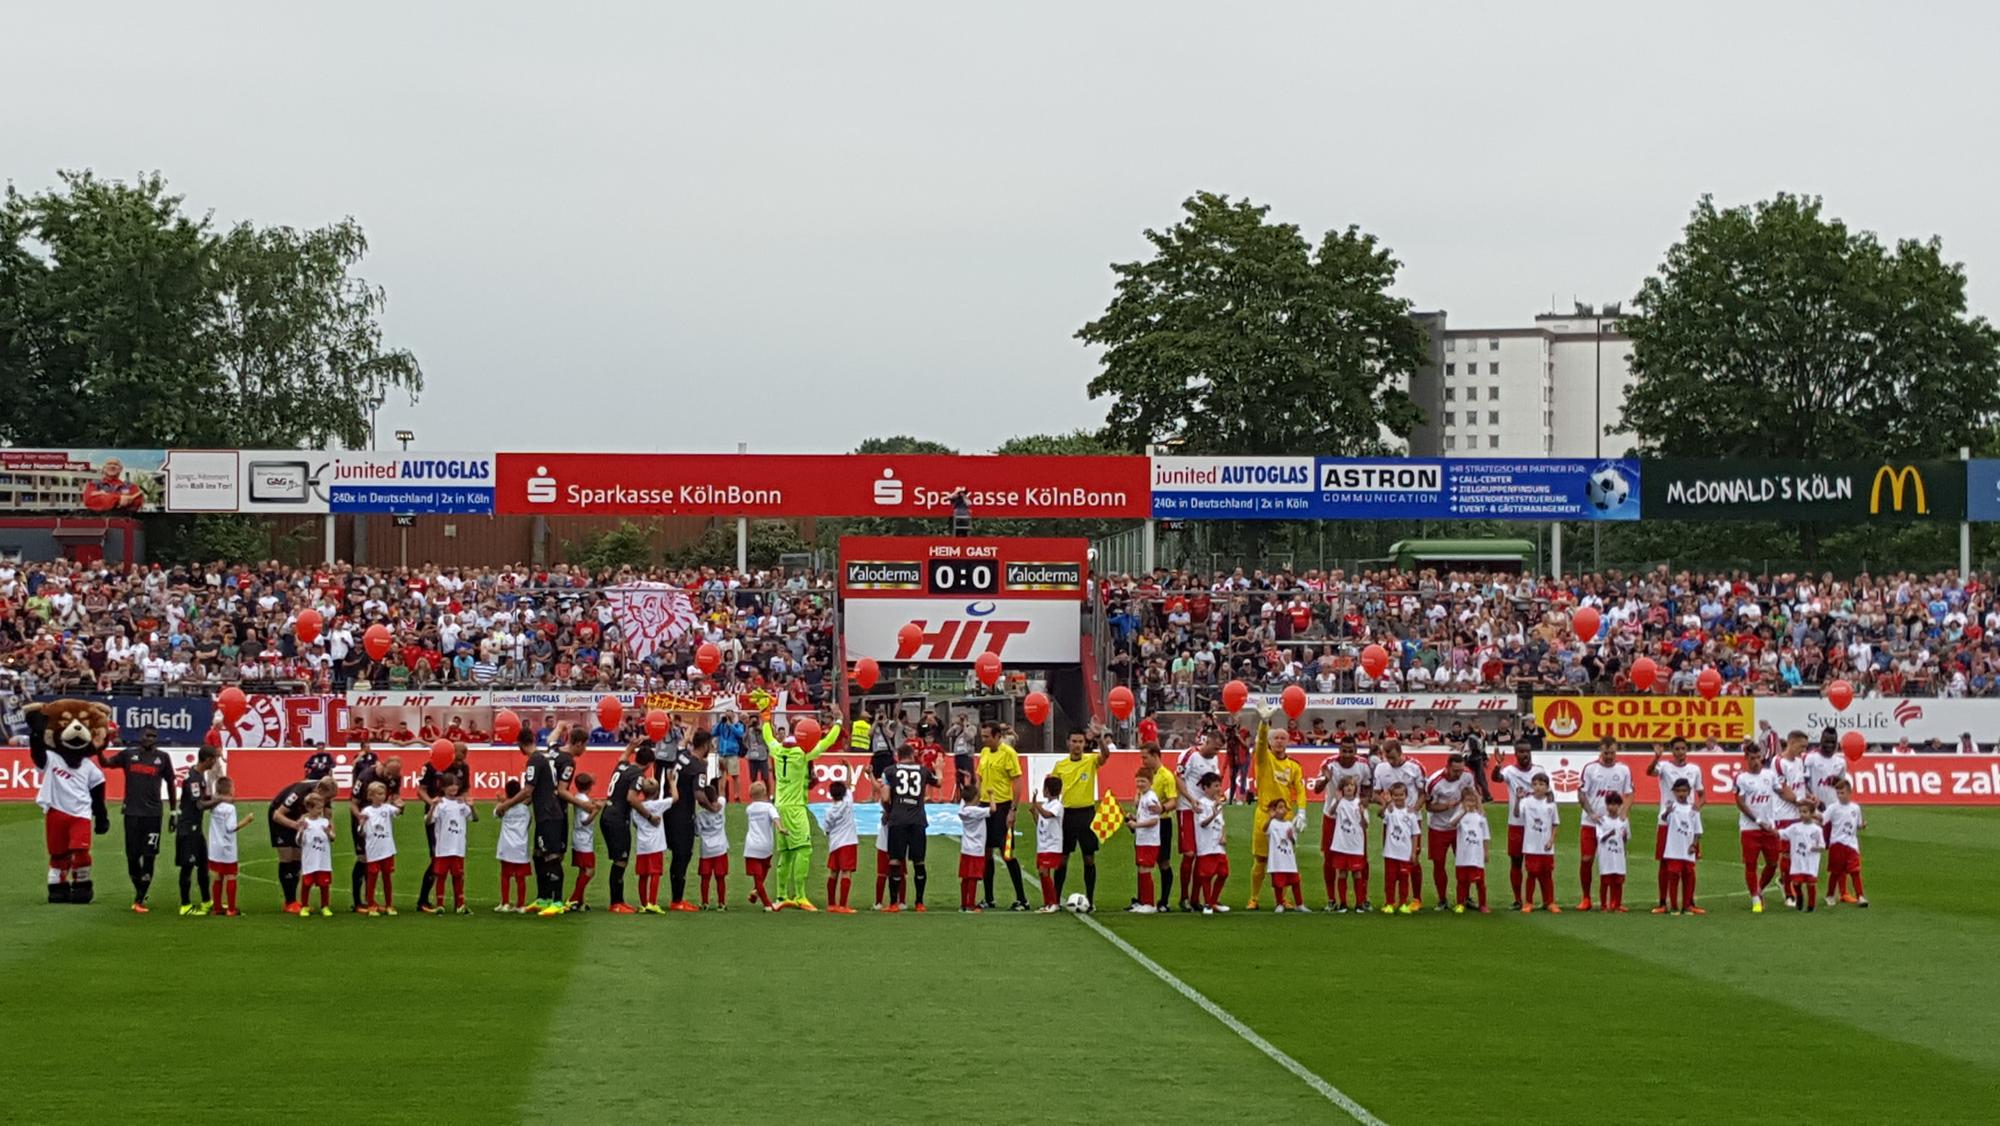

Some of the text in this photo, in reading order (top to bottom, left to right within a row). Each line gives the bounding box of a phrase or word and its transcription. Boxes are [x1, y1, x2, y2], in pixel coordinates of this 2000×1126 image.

[334, 459, 490, 480] junited AUTOGLAS
[1156, 464, 1308, 486] junited AUTOGLAS
[1464, 466, 1528, 474] STRATEGISCHER
[1324, 469, 1437, 488] ASTRON
[1797, 473, 1852, 501] KÖLN
[332, 492, 490, 504] 240x in Deutschland 2x in Köln
[567, 484, 782, 507] Sparkasse KölnBonn
[1025, 487, 1126, 507] KölnBonn
[1323, 493, 1438, 503] COMMUNICATION
[1458, 495, 1568, 503] AUSSENDIENSTSTEUERUNG
[1154, 498, 1308, 509] 240x in Deutschland 2x in Köln
[1498, 504, 1581, 512] GÄSTEMANAGEMENT
[397, 517, 412, 525] WC
[1170, 521, 1184, 529] WC
[929, 546, 998, 557] HEIM GAST
[849, 565, 920, 582] Kaloderma
[1008, 566, 1078, 584] Kaloderma
[894, 620, 1030, 660] HIT
[356, 695, 387, 706] HIT
[403, 695, 434, 706] HIT
[450, 695, 482, 706] HIT
[521, 694, 560, 703] AUTOGLAS
[1336, 696, 1374, 705] AUTOGLAS
[1385, 699, 1415, 709] HIT
[1432, 699, 1462, 709] HIT
[1478, 699, 1508, 709] HIT
[1592, 700, 1744, 716] COLONIA
[126, 706, 192, 732] Kölsch
[1592, 718, 1744, 739] UMZÜGE
[607, 771, 620, 796] 8
[896, 769, 922, 797] 33
